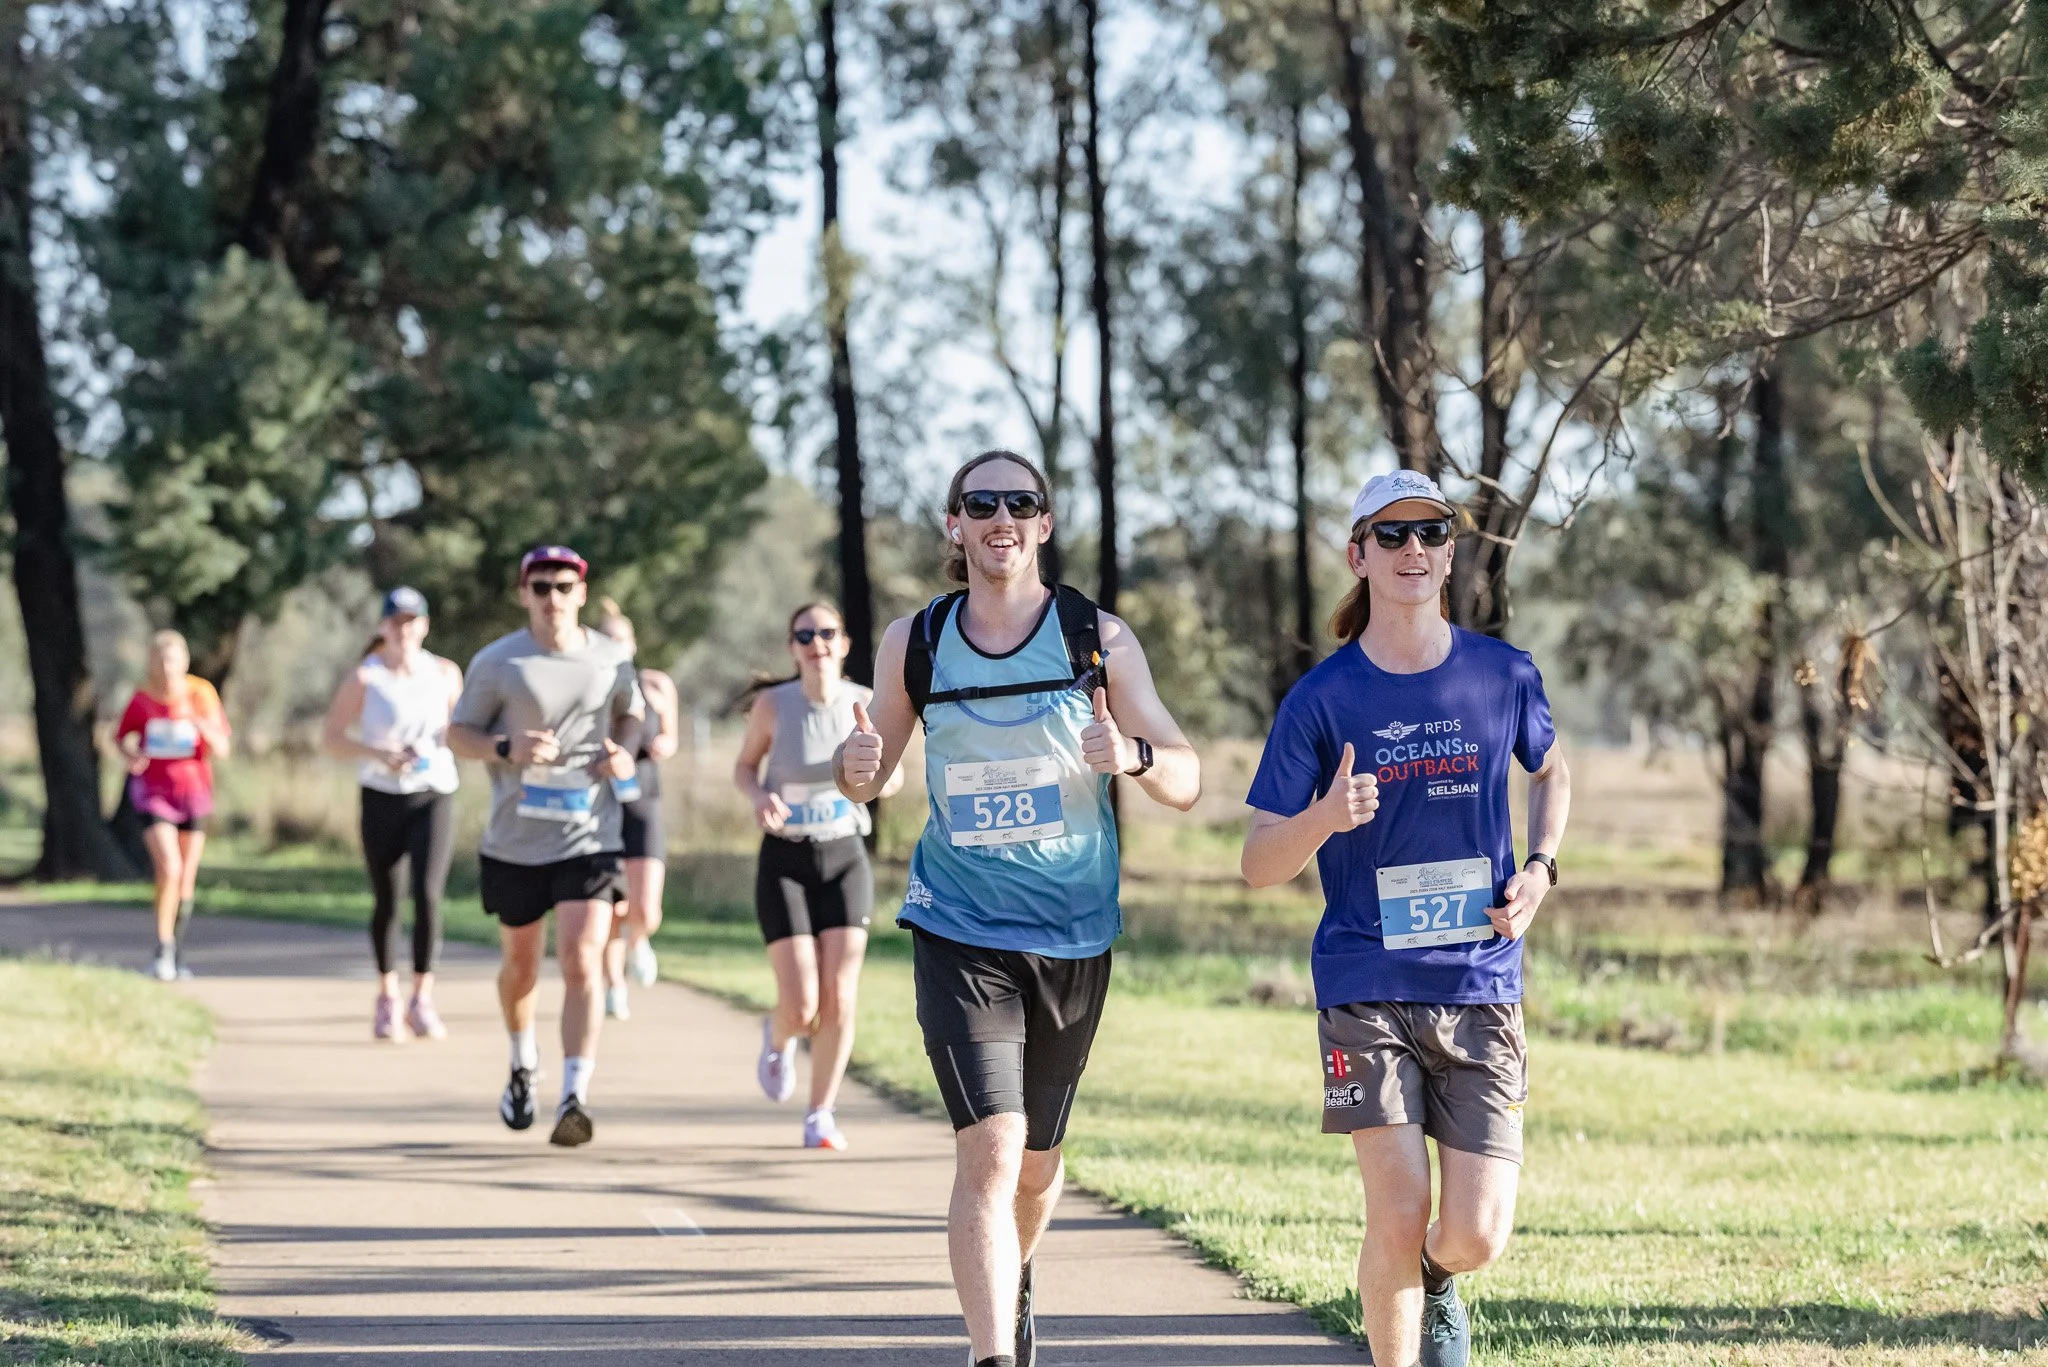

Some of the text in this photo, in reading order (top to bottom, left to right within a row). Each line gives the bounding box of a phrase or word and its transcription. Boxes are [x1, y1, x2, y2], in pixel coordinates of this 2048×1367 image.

[1424, 719, 1462, 735] RFDS
[1375, 738, 1479, 765] OCEANS to
[1377, 755, 1479, 783] OUTBACK
[1427, 783, 1479, 797] KELSIAN
[974, 792, 1037, 829] 528
[1409, 893, 1468, 931] 527
